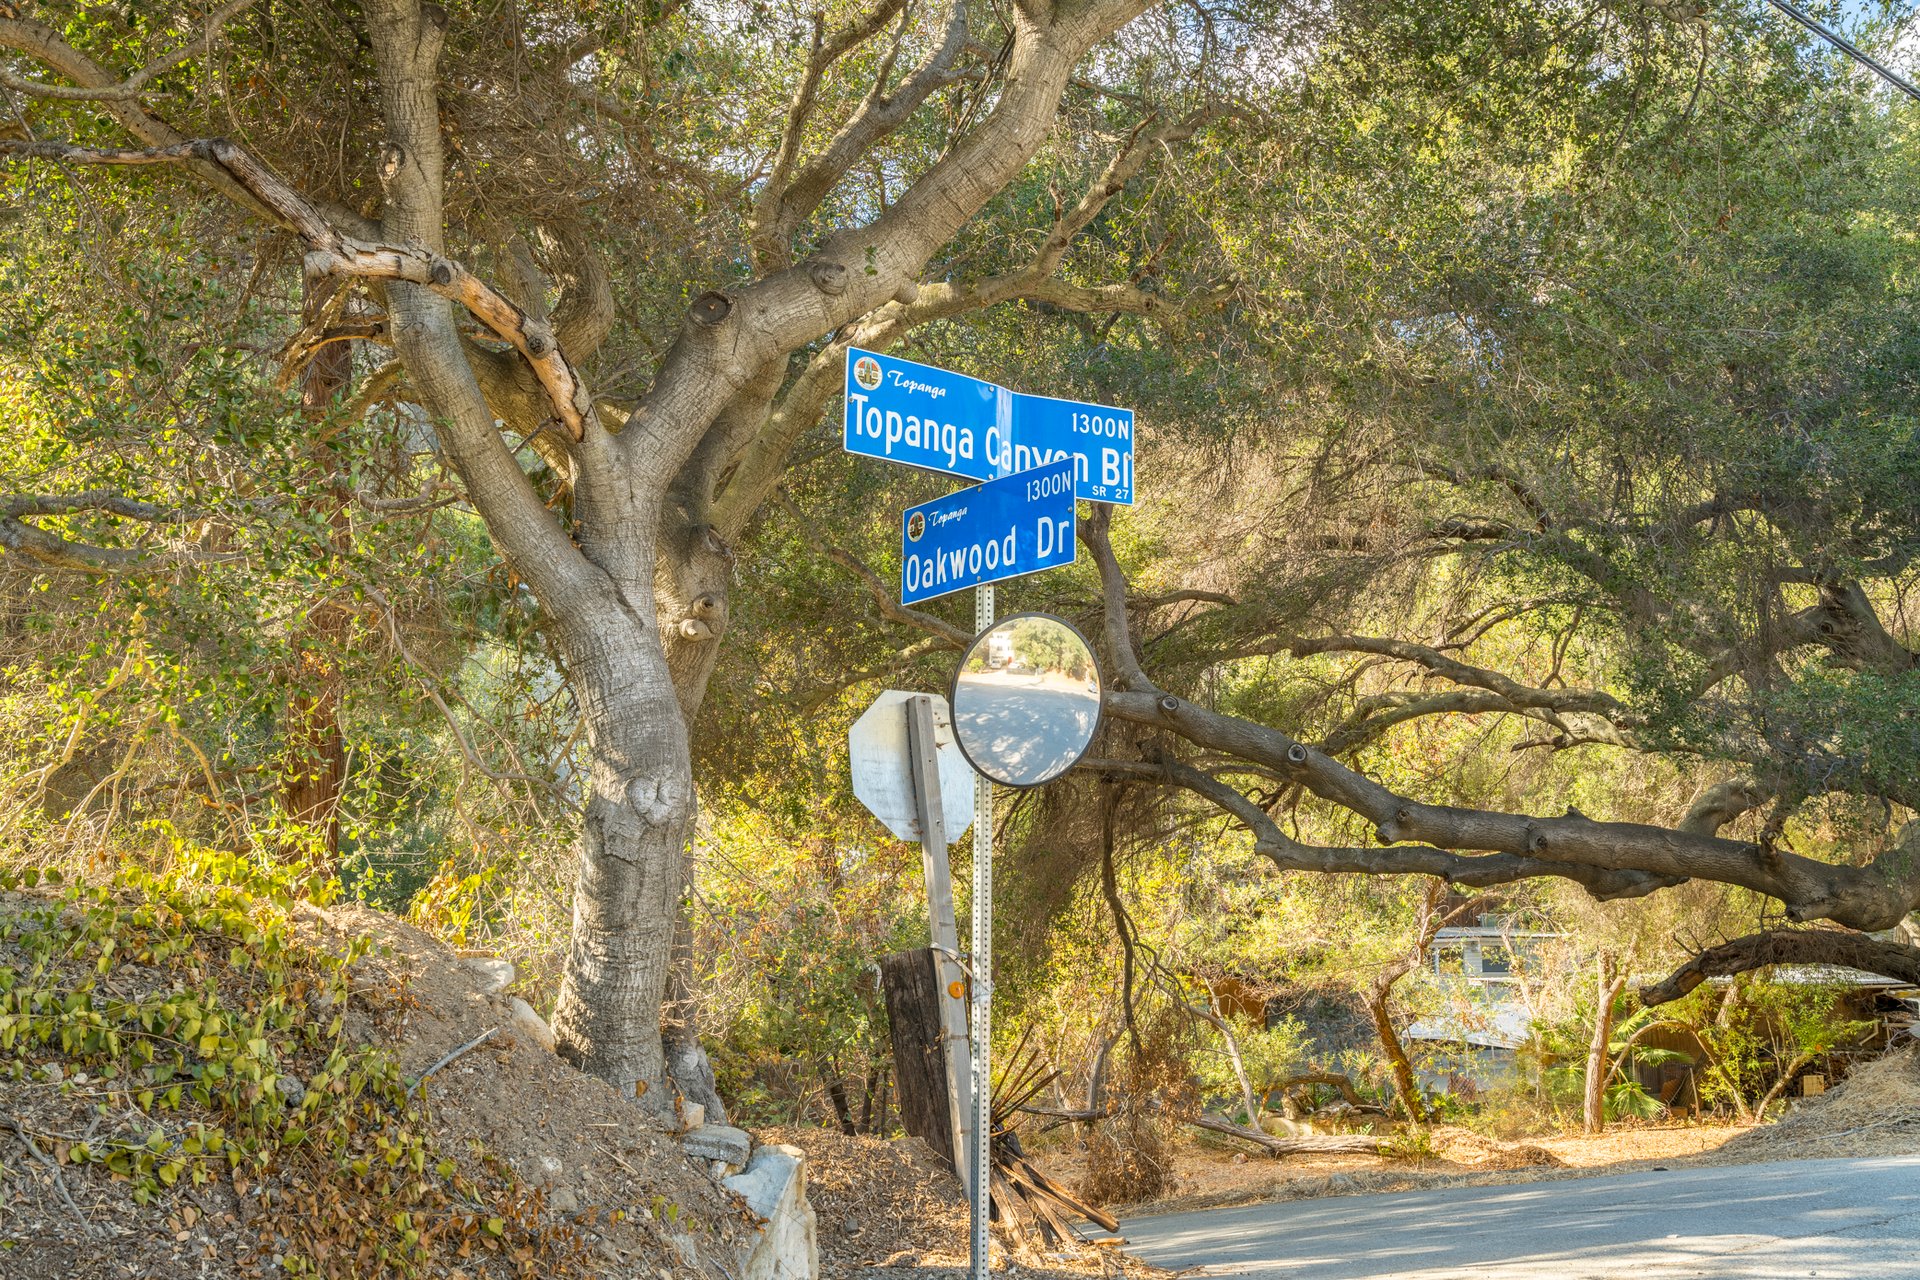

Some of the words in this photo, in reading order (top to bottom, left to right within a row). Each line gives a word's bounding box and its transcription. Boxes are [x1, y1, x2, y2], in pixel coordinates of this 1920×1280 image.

[887, 370, 946, 398] Topanga
[851, 393, 974, 468] Topanga
[1072, 413, 1129, 440] 1300N
[1026, 470, 1071, 502] 1300N
[1092, 485, 1107, 497] SR
[1115, 488, 1129, 500] 27
[928, 506, 967, 526] Topanga
[906, 525, 1016, 593] Oakwood
[1037, 516, 1069, 558] Dr
